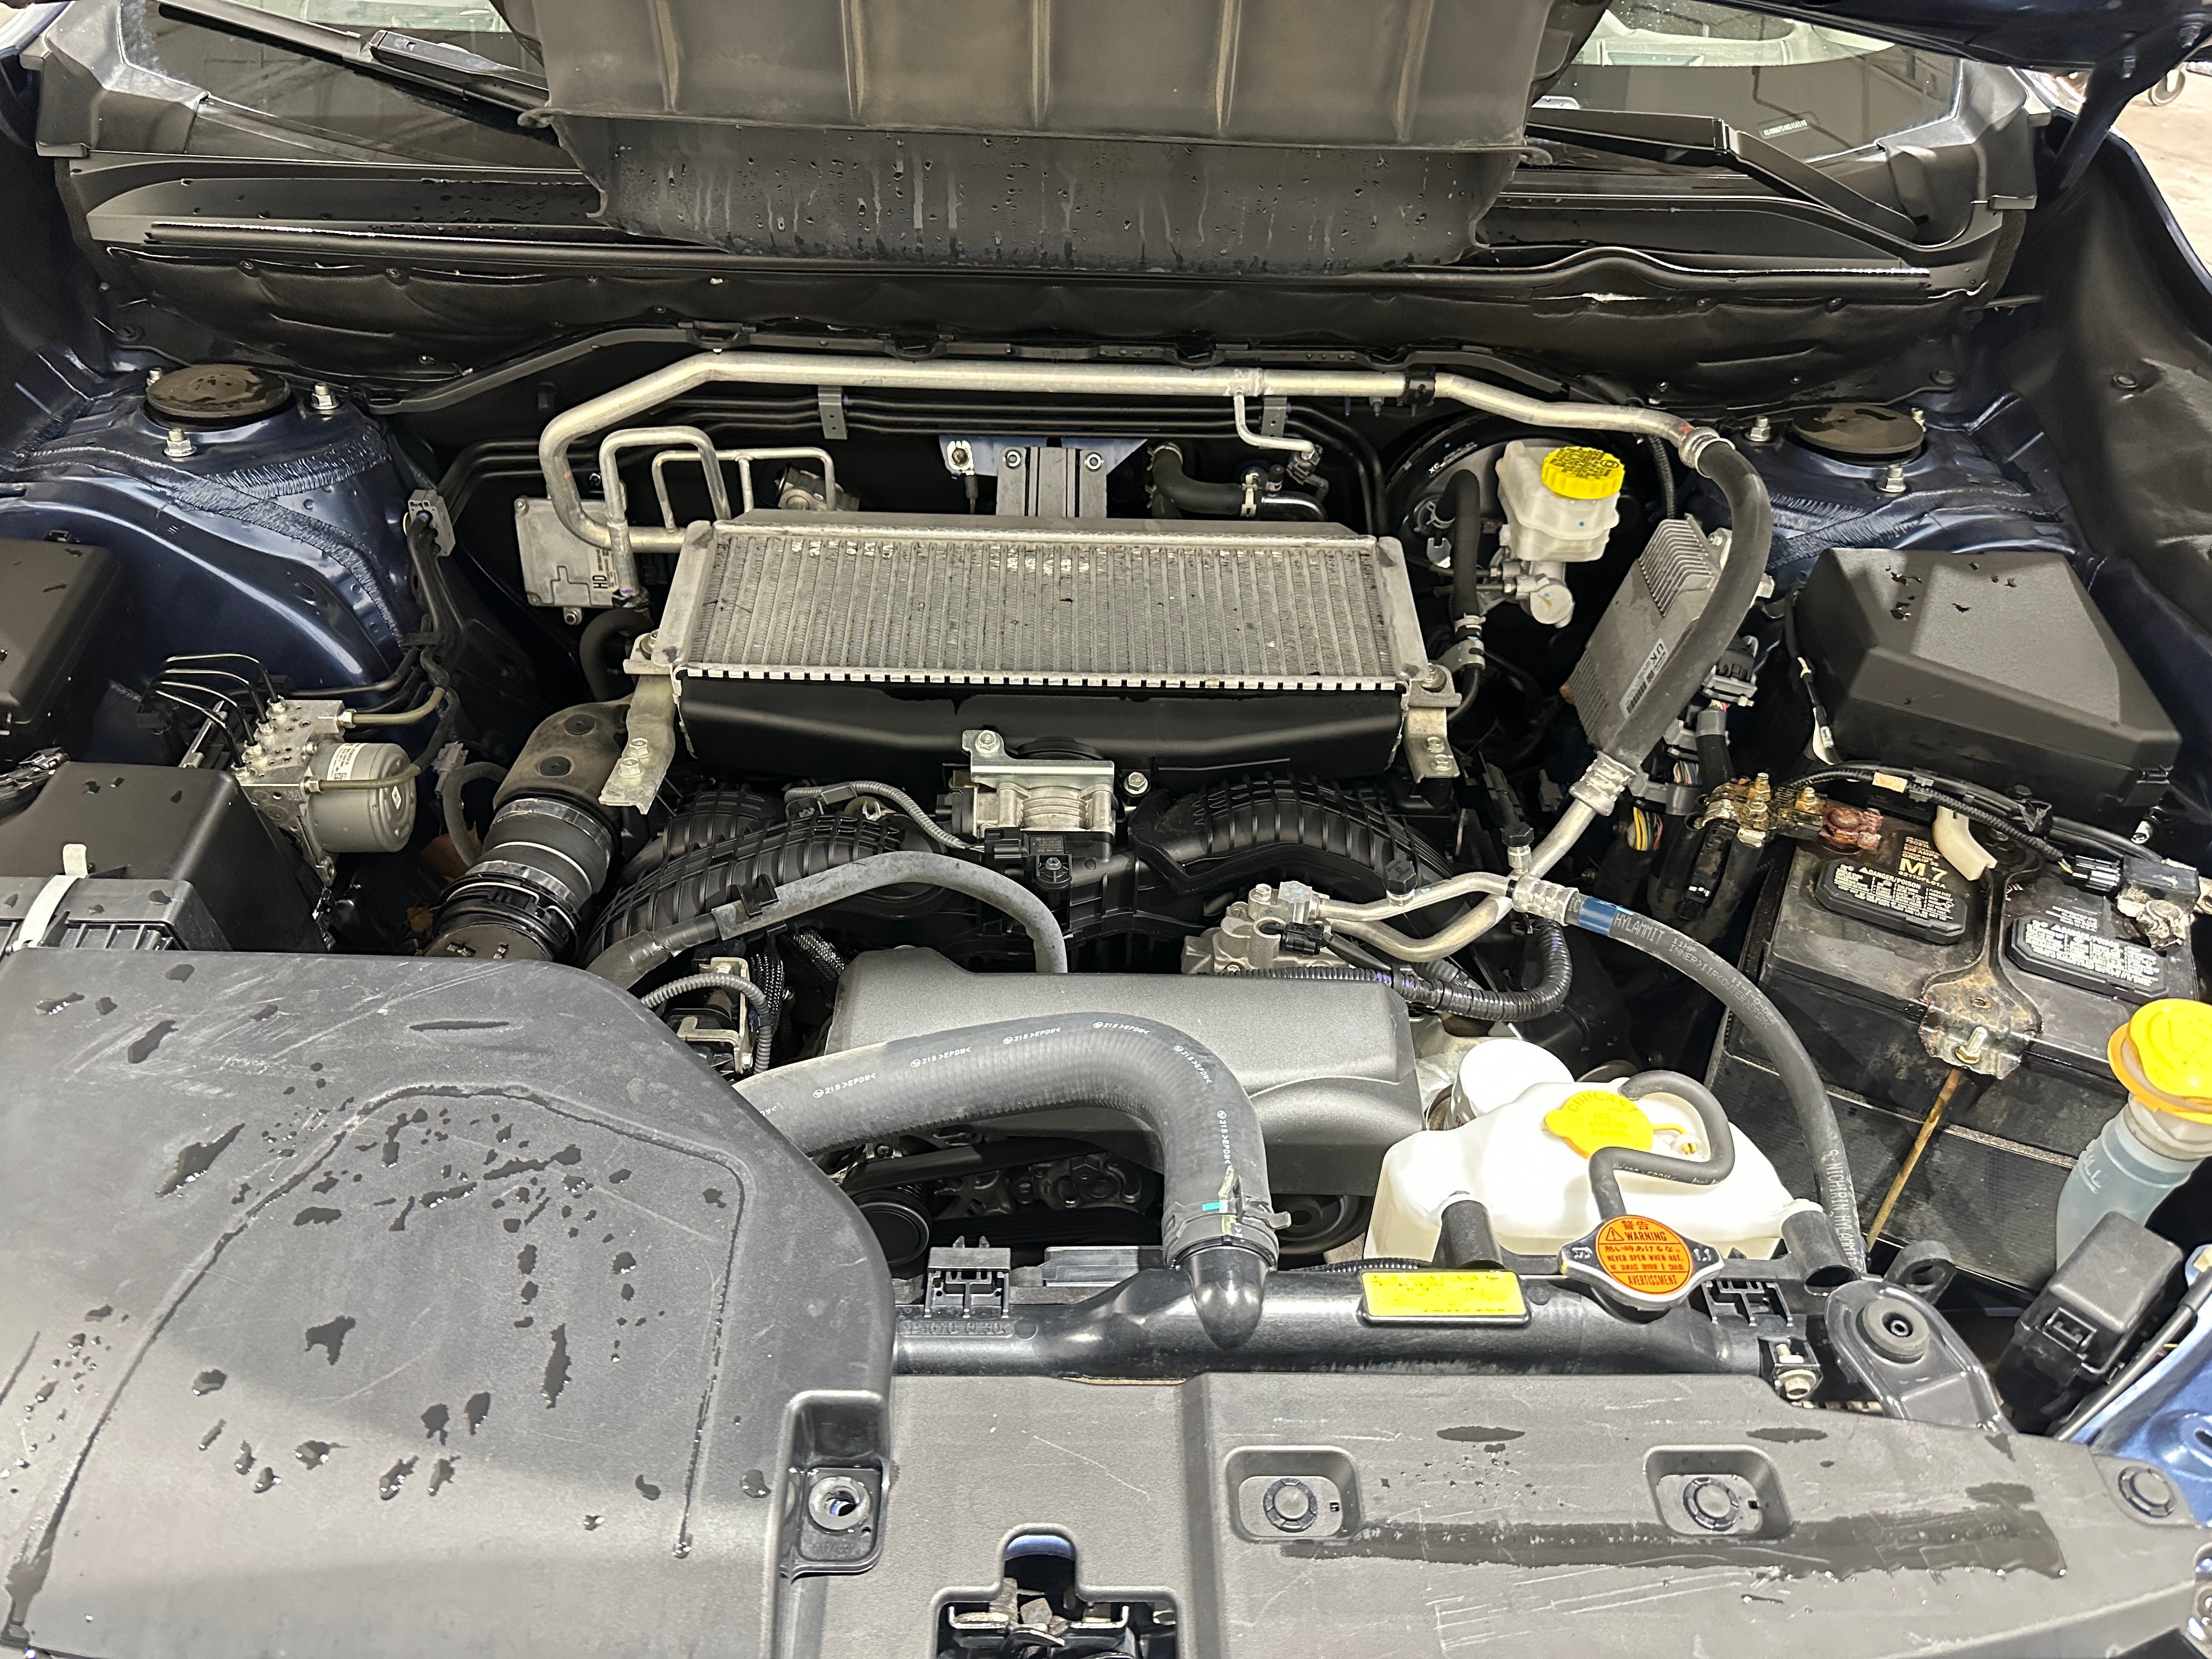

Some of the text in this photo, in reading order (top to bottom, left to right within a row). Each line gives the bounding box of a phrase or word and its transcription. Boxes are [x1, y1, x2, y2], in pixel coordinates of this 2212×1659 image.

[592, 575, 608, 588] HD
[1650, 644, 1663, 664] UK
[1613, 912, 1665, 944] HYLAMMIT
[1567, 1092, 1638, 1112] COOLANT
[1622, 1220, 1649, 1230] 警告
[1624, 1232, 1667, 1241] WARNING
